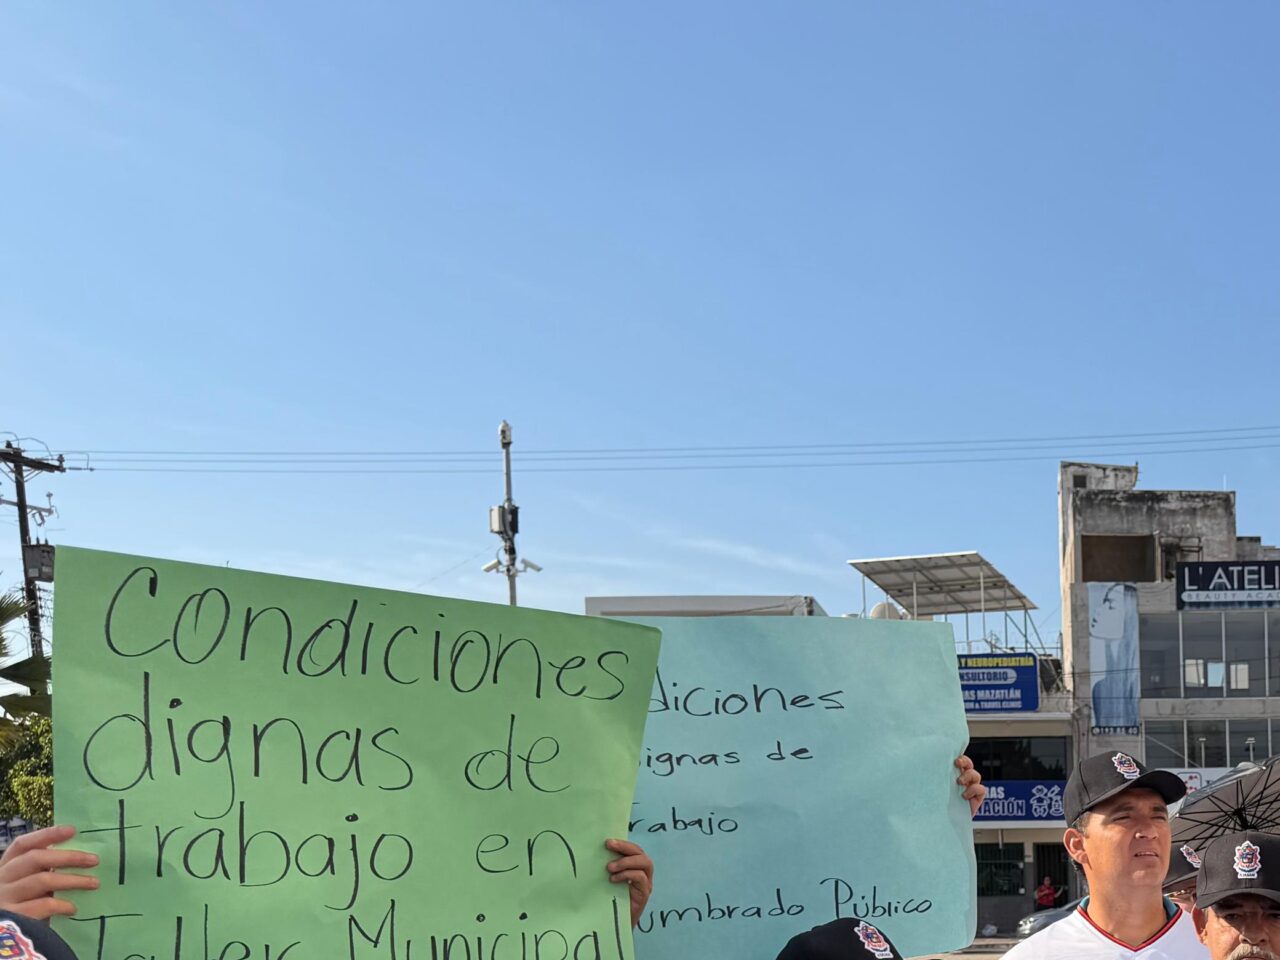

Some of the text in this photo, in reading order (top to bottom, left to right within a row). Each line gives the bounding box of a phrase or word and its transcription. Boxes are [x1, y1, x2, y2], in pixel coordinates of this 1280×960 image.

[1187, 591, 1236, 600] BEAUTY
[105, 566, 629, 700] Condiciones
[83, 672, 572, 819] dignas de
[639, 740, 814, 777] ignas de
[628, 802, 739, 836] rabajo
[475, 829, 577, 880] en
[819, 877, 933, 919] Público
